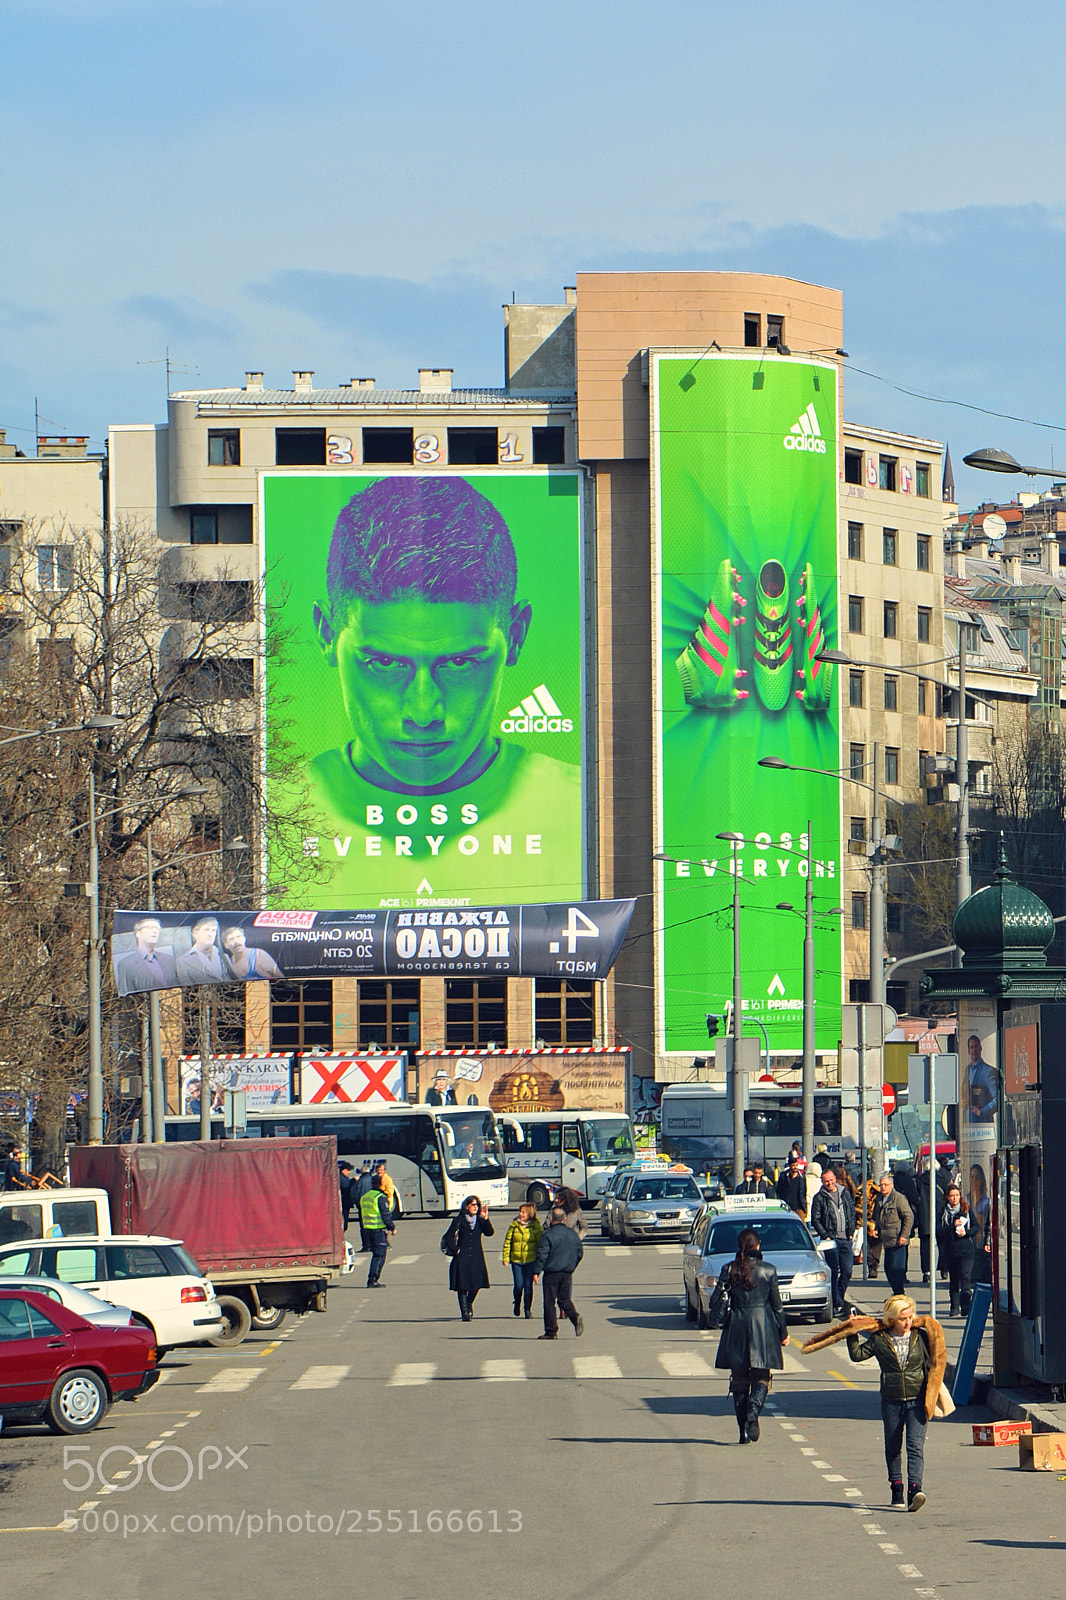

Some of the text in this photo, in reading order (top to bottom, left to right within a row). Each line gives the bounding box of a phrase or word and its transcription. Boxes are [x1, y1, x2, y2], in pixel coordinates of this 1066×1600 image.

[783, 433, 827, 455] adidas
[500, 714, 574, 733] adidas
[366, 804, 479, 825] BOSS
[302, 834, 543, 857] EVERYONE
[730, 832, 810, 851] BOSS
[676, 858, 836, 878] EVERYONE
[379, 898, 400, 907] ACE
[416, 897, 471, 907] PRIMEKNIT
[724, 999, 749, 1010] AE
[907, 1032, 935, 1042] ZAŠTI
[246, 1063, 289, 1073] KARAN
